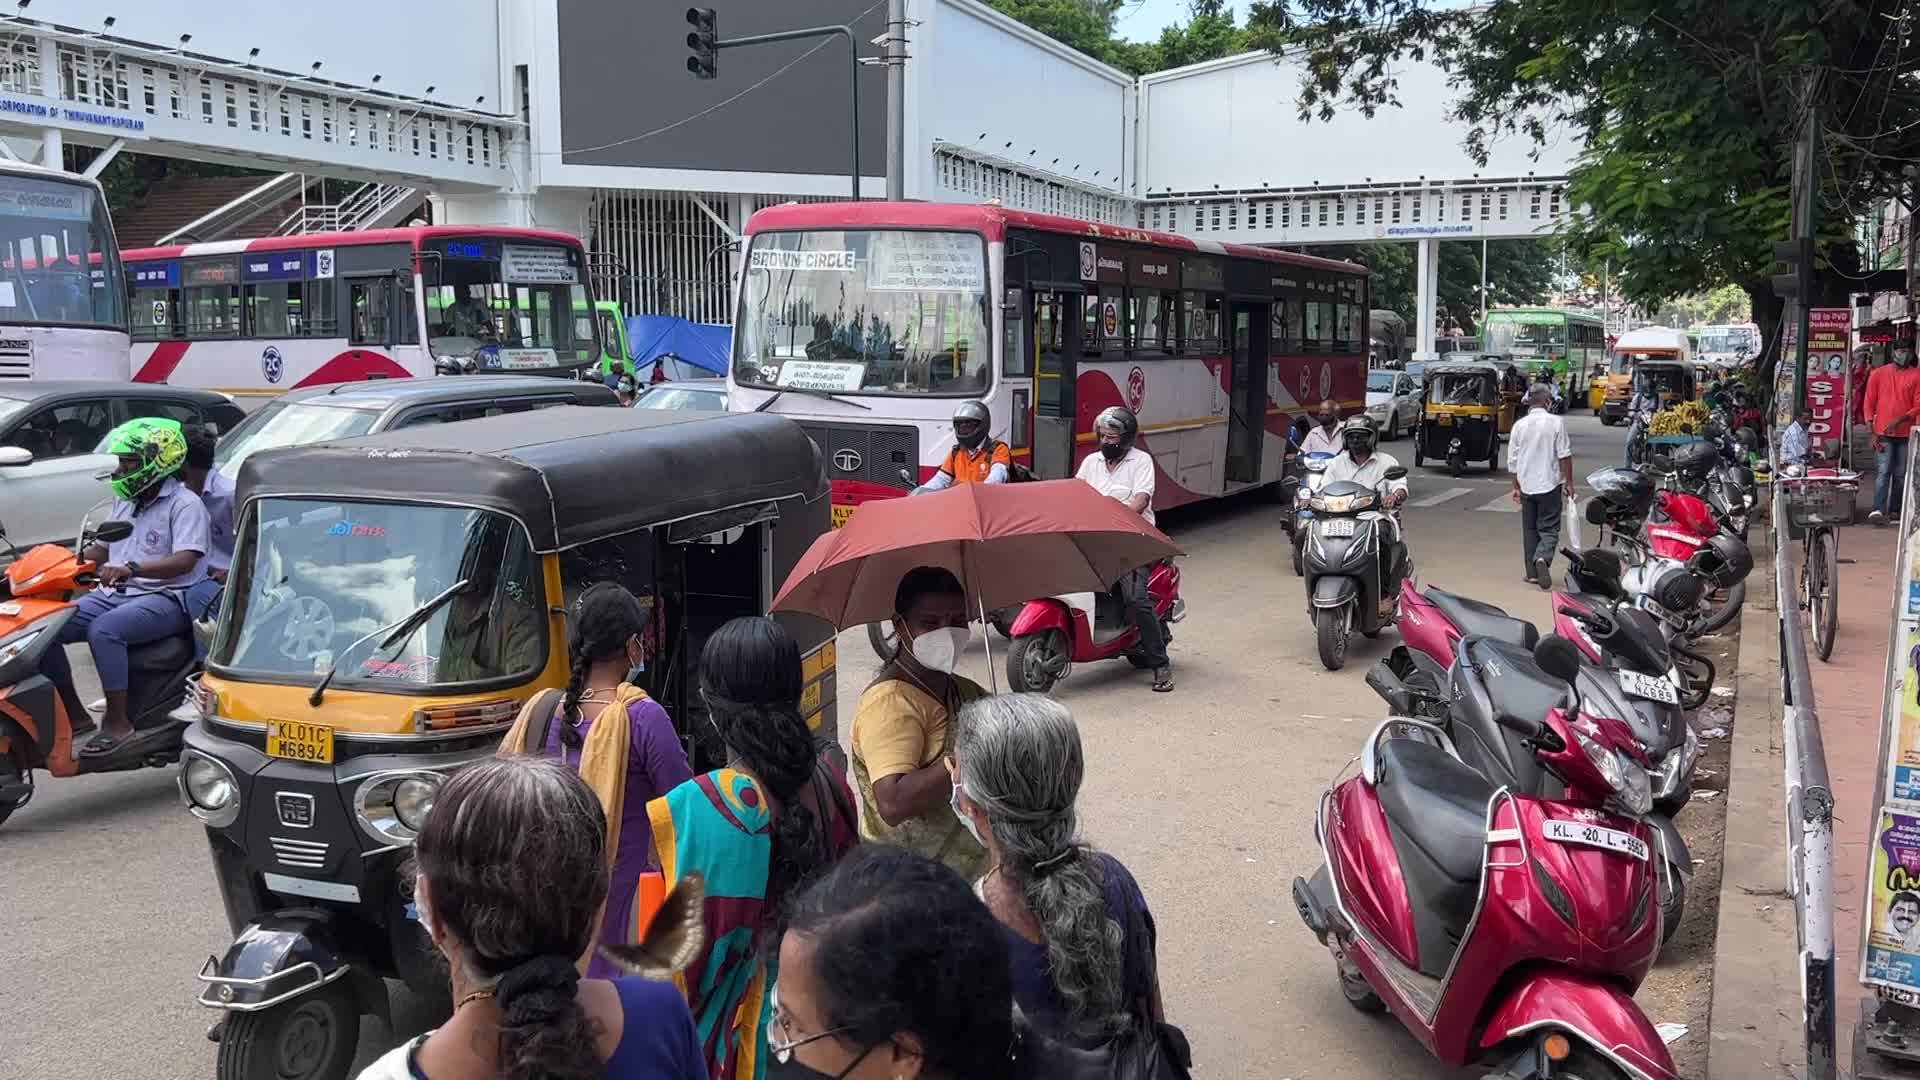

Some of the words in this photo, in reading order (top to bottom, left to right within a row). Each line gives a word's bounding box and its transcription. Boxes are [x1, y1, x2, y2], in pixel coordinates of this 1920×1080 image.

[752, 251, 800, 267] BROWN
[806, 253, 854, 269] CIRCLE
[265, 358, 279, 372] 2C
[1808, 381, 1833, 458] STUDI
[279, 722, 325, 743] KL01C
[279, 741, 325, 761] M6894
